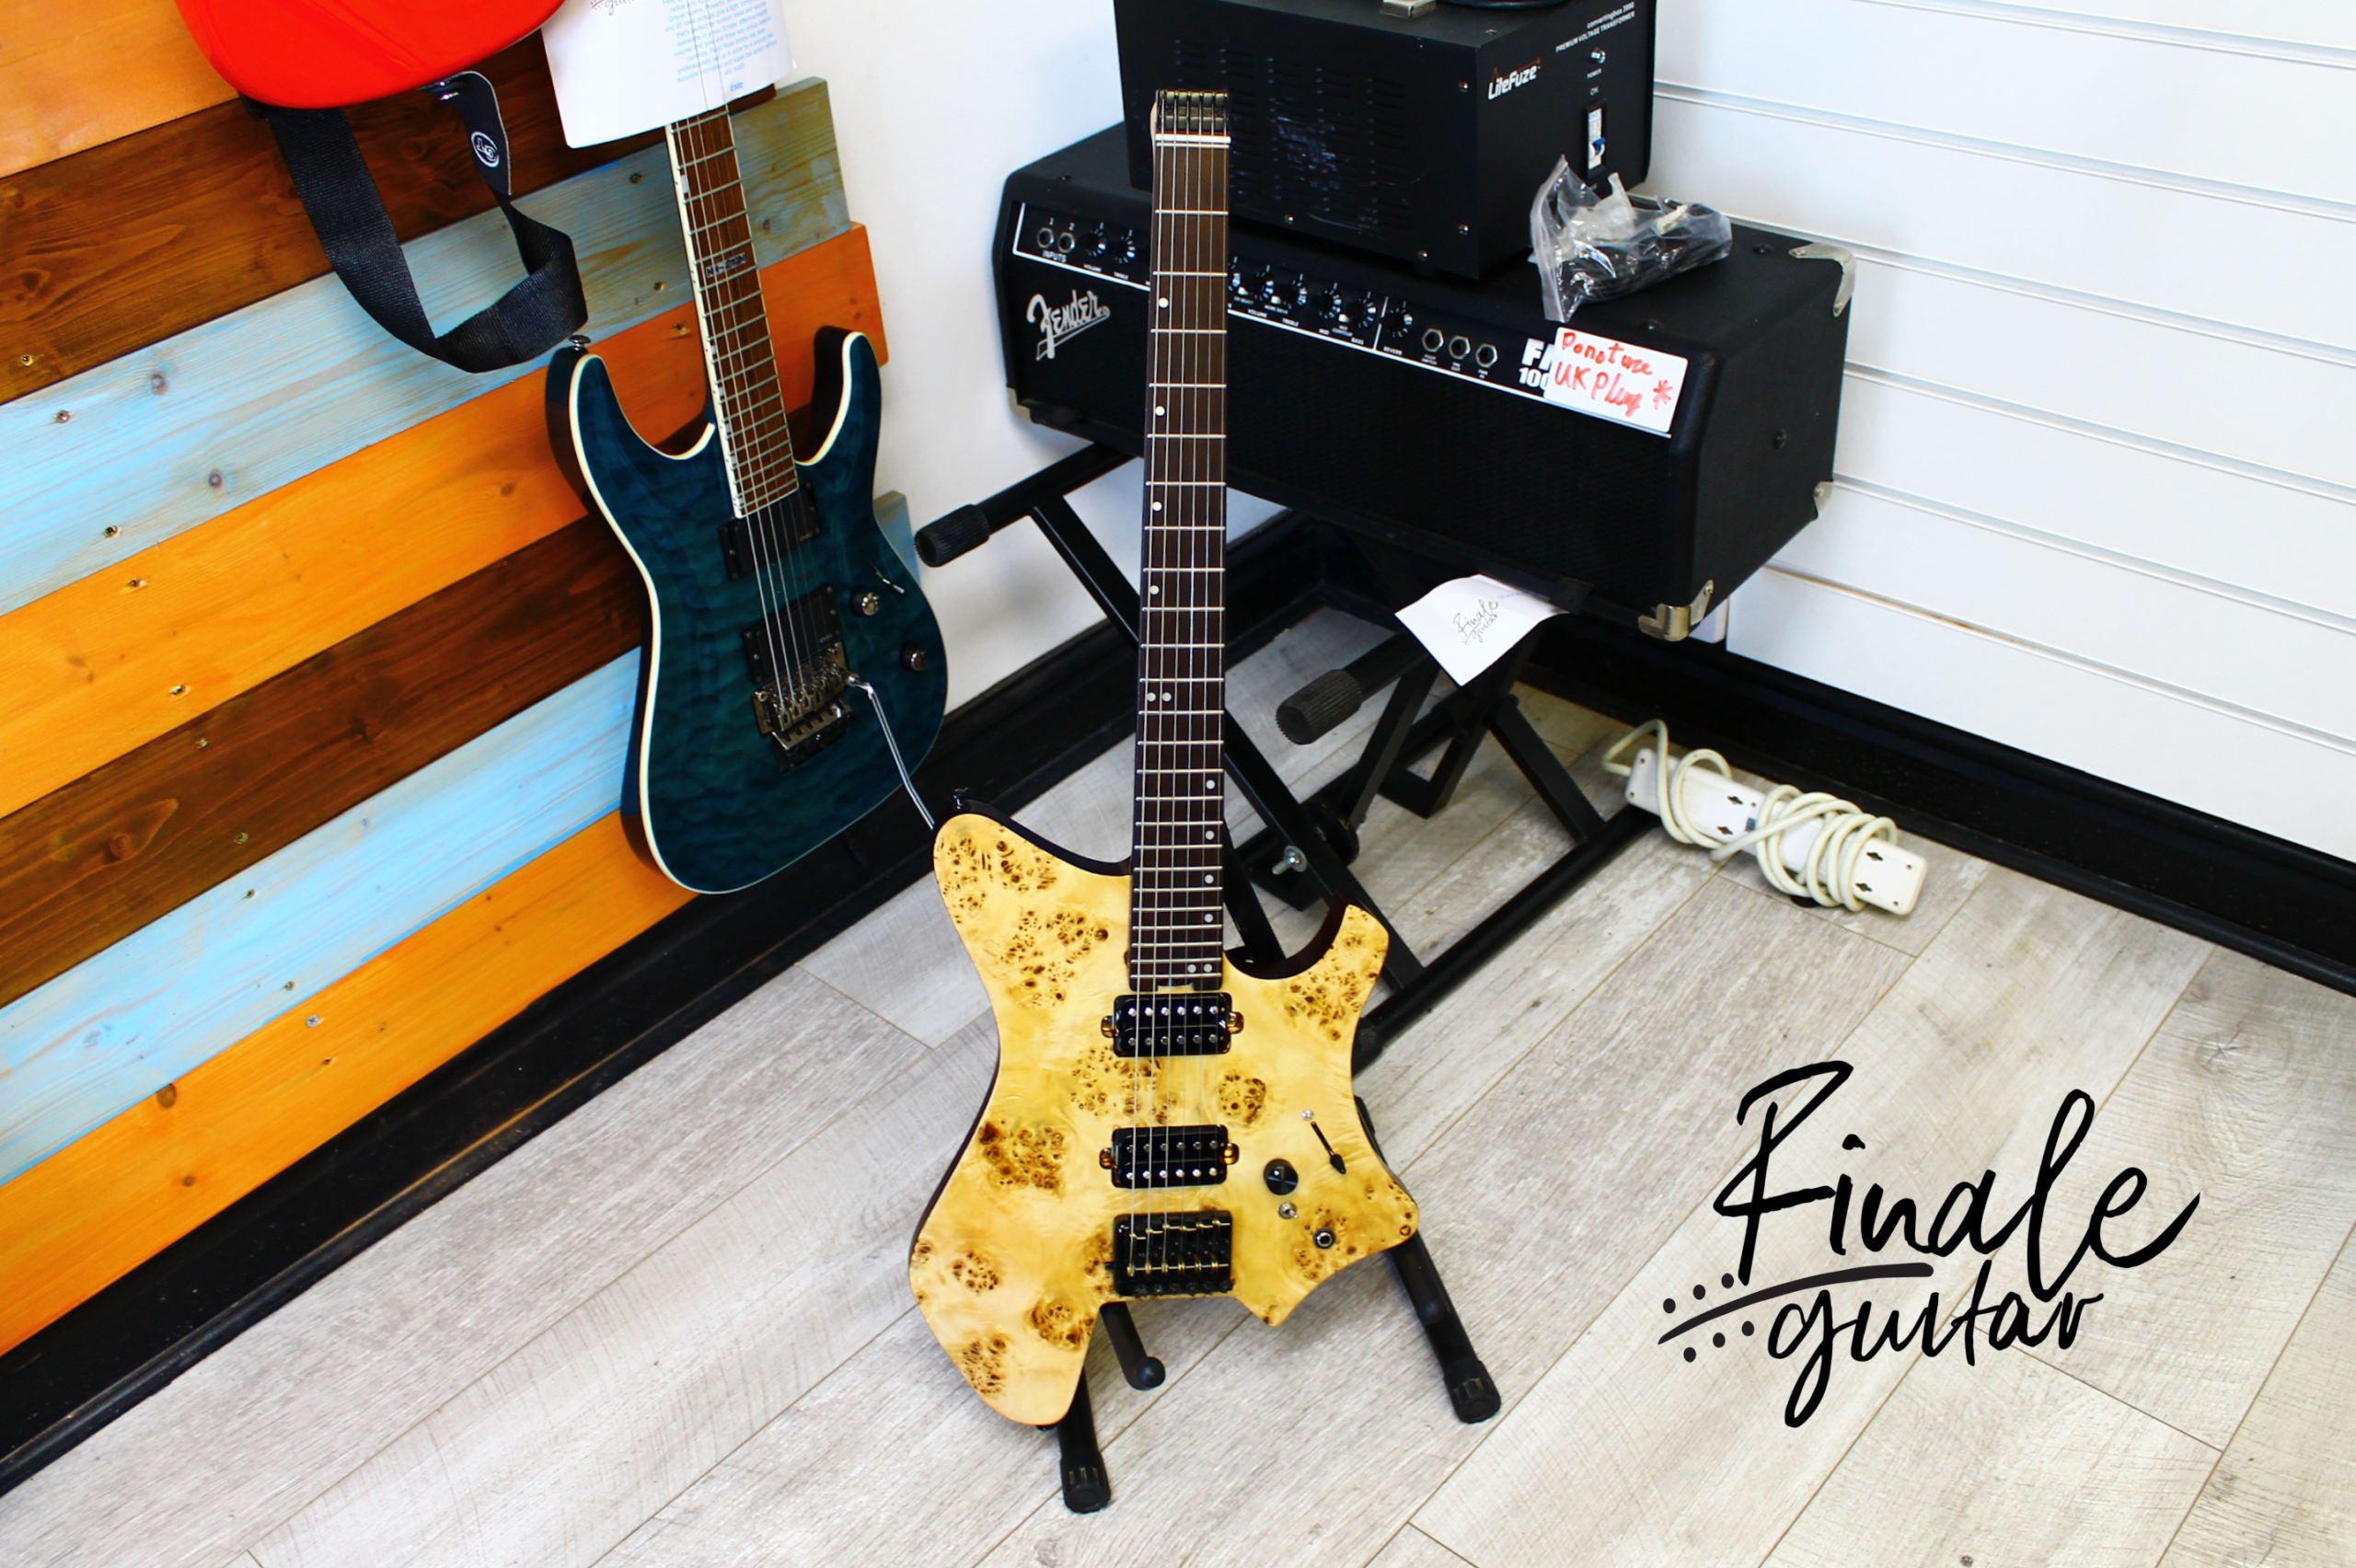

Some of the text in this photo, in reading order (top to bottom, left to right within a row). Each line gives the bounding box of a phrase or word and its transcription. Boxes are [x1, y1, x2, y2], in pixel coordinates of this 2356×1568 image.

[1578, 27, 1600, 42] VOLTAGE
[1488, 65, 1537, 100] LiteFuze
[1042, 249, 1068, 263] INPUTS
[1026, 289, 1111, 361] Fender
[1554, 361, 1591, 390] UK
